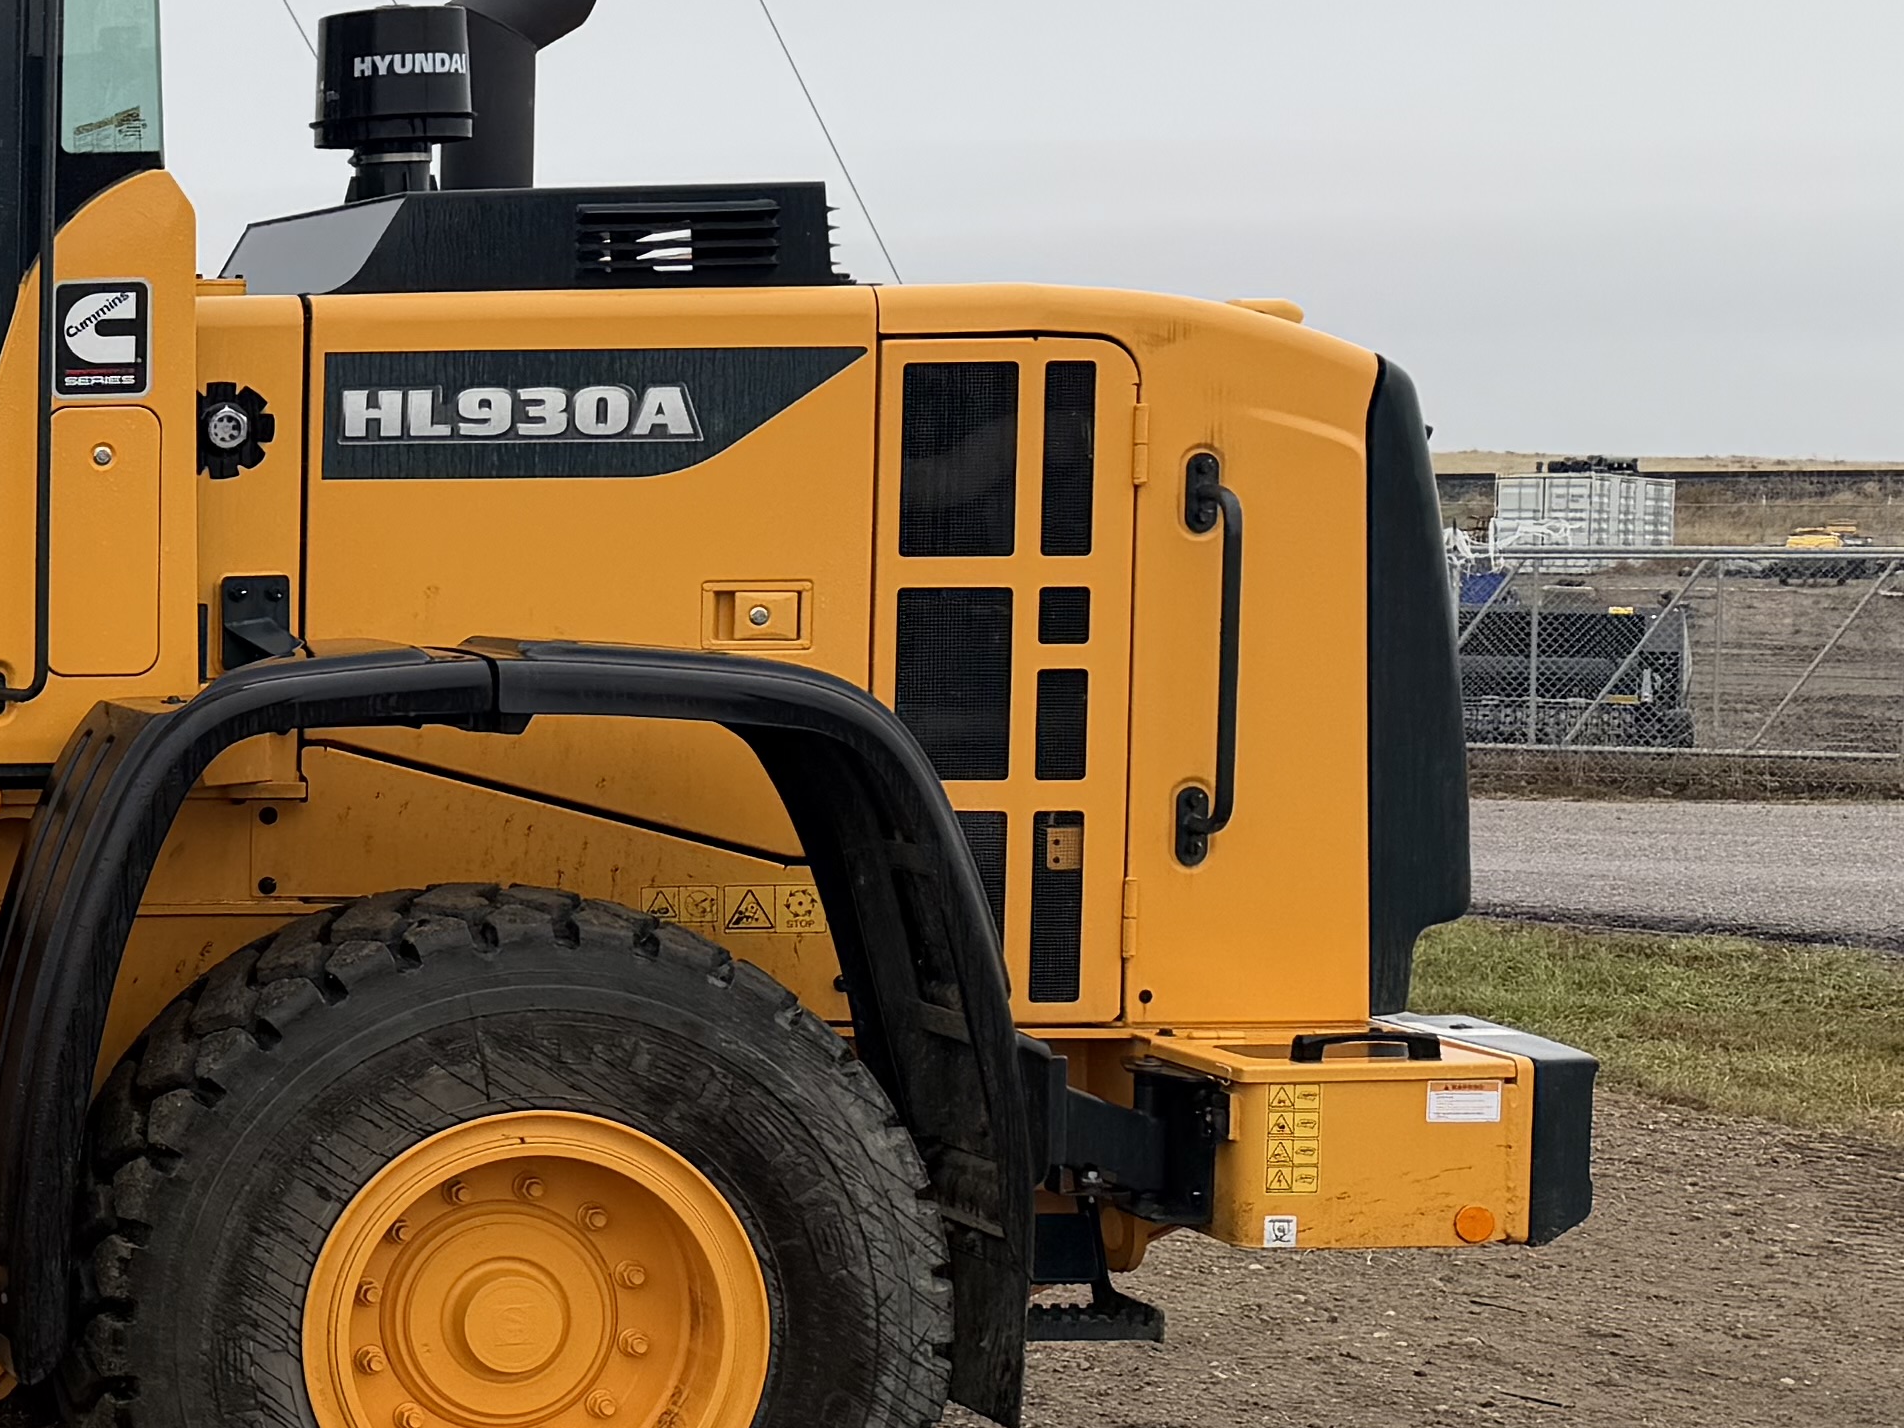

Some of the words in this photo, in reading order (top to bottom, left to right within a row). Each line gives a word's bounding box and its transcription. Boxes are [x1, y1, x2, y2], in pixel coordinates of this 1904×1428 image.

[353, 52, 467, 78] HYUNDAI
[65, 291, 130, 338] Cummins
[64, 375, 136, 387] SERIES
[343, 385, 695, 438] HL930A
[785, 919, 815, 929] STOP
